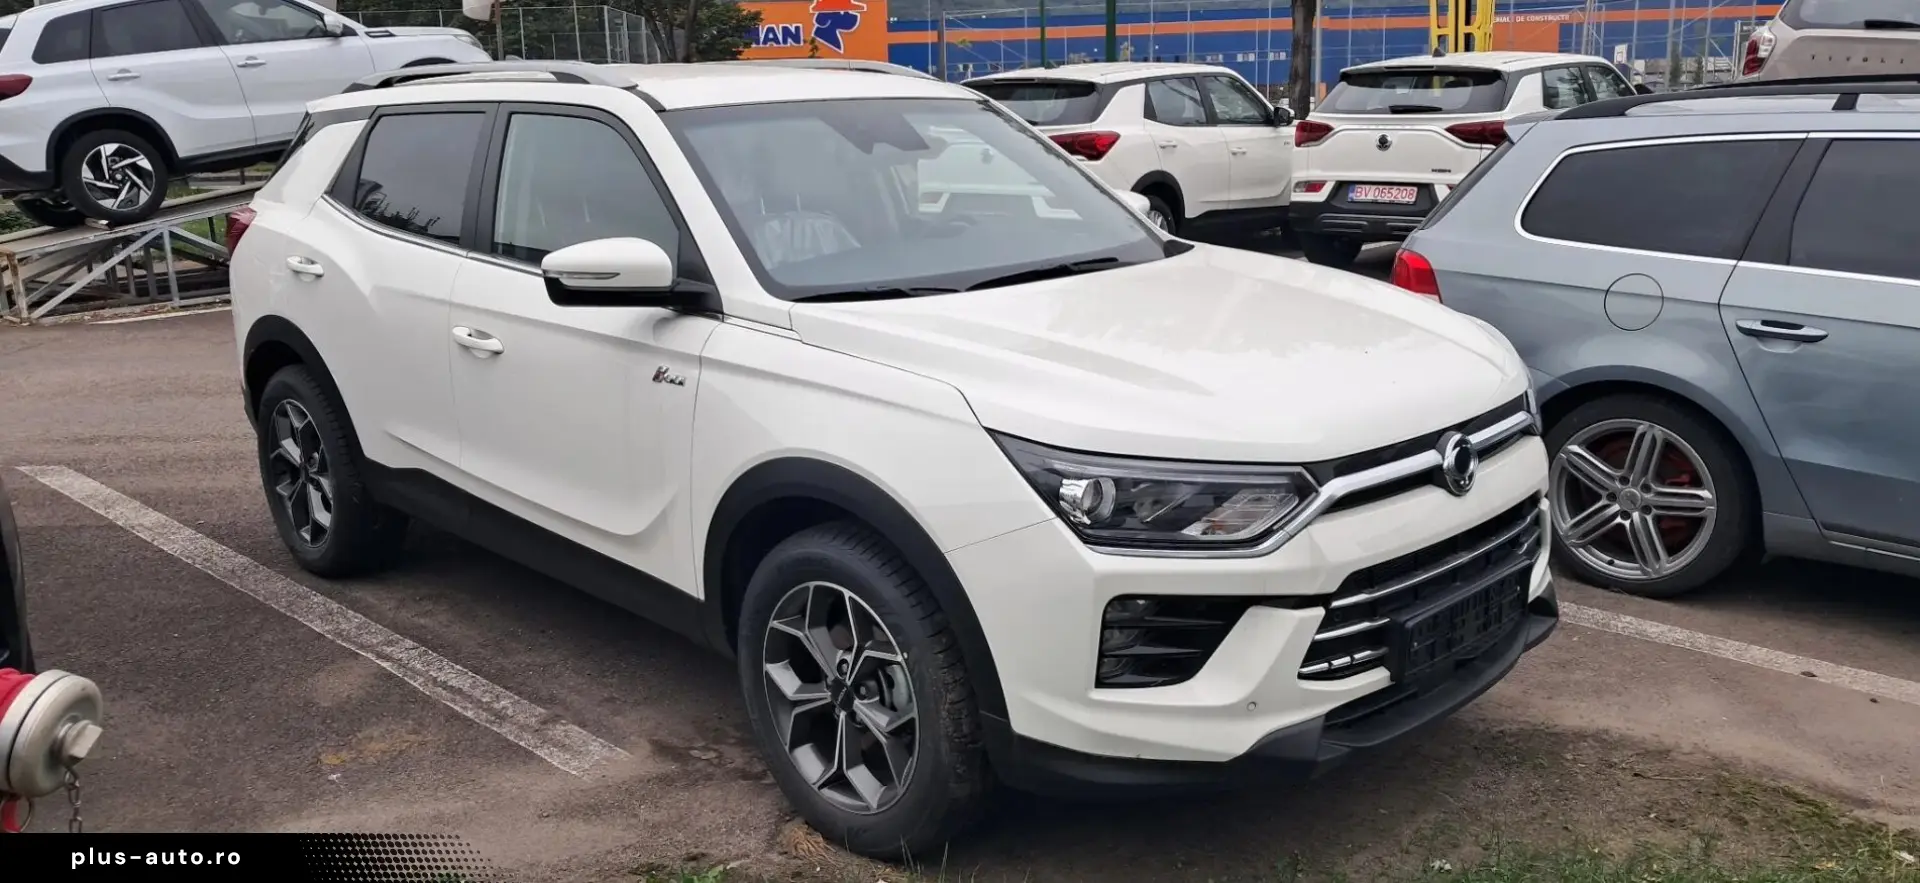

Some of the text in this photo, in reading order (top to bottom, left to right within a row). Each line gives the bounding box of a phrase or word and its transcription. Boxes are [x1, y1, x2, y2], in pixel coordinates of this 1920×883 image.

[1811, 54, 1904, 64] TIVOLI
[1355, 186, 1416, 200] BV 065208
